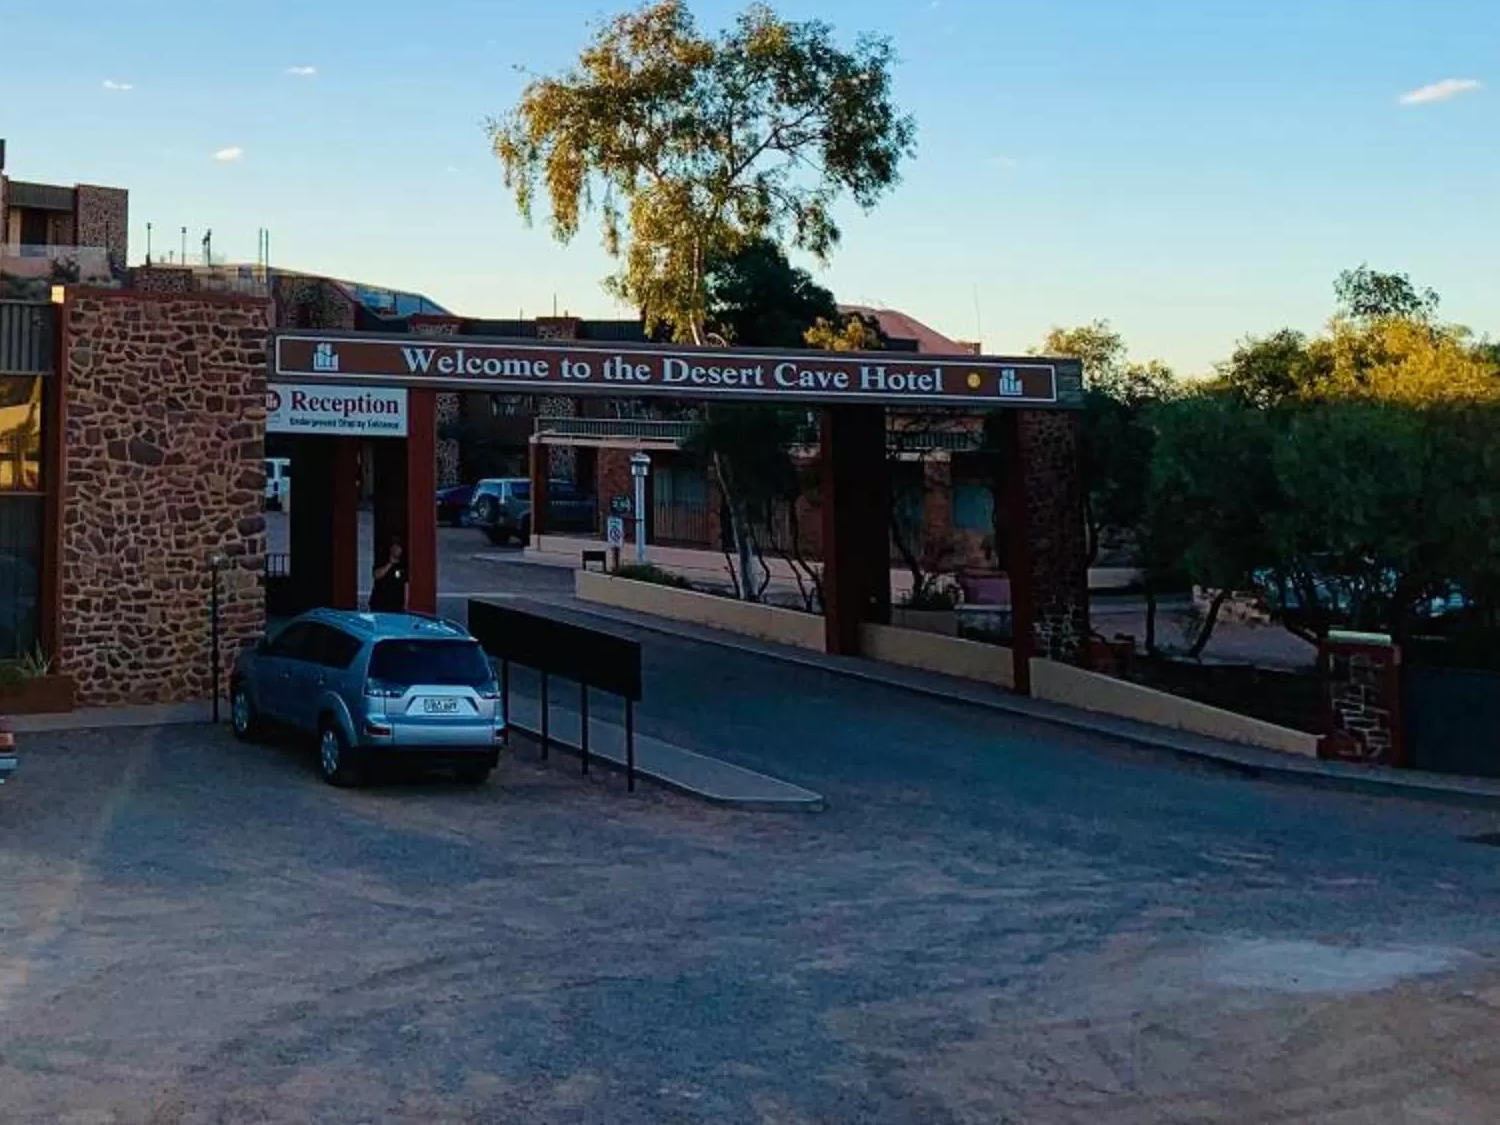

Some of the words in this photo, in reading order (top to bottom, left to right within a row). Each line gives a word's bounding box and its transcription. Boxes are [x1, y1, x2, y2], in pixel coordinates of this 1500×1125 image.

[401, 347, 549, 376] Welcome
[560, 356, 591, 379] to
[602, 353, 651, 381] the
[661, 357, 764, 386] Desert
[773, 362, 850, 388] Cave
[860, 365, 944, 393] Hotel
[290, 390, 399, 417] Reception
